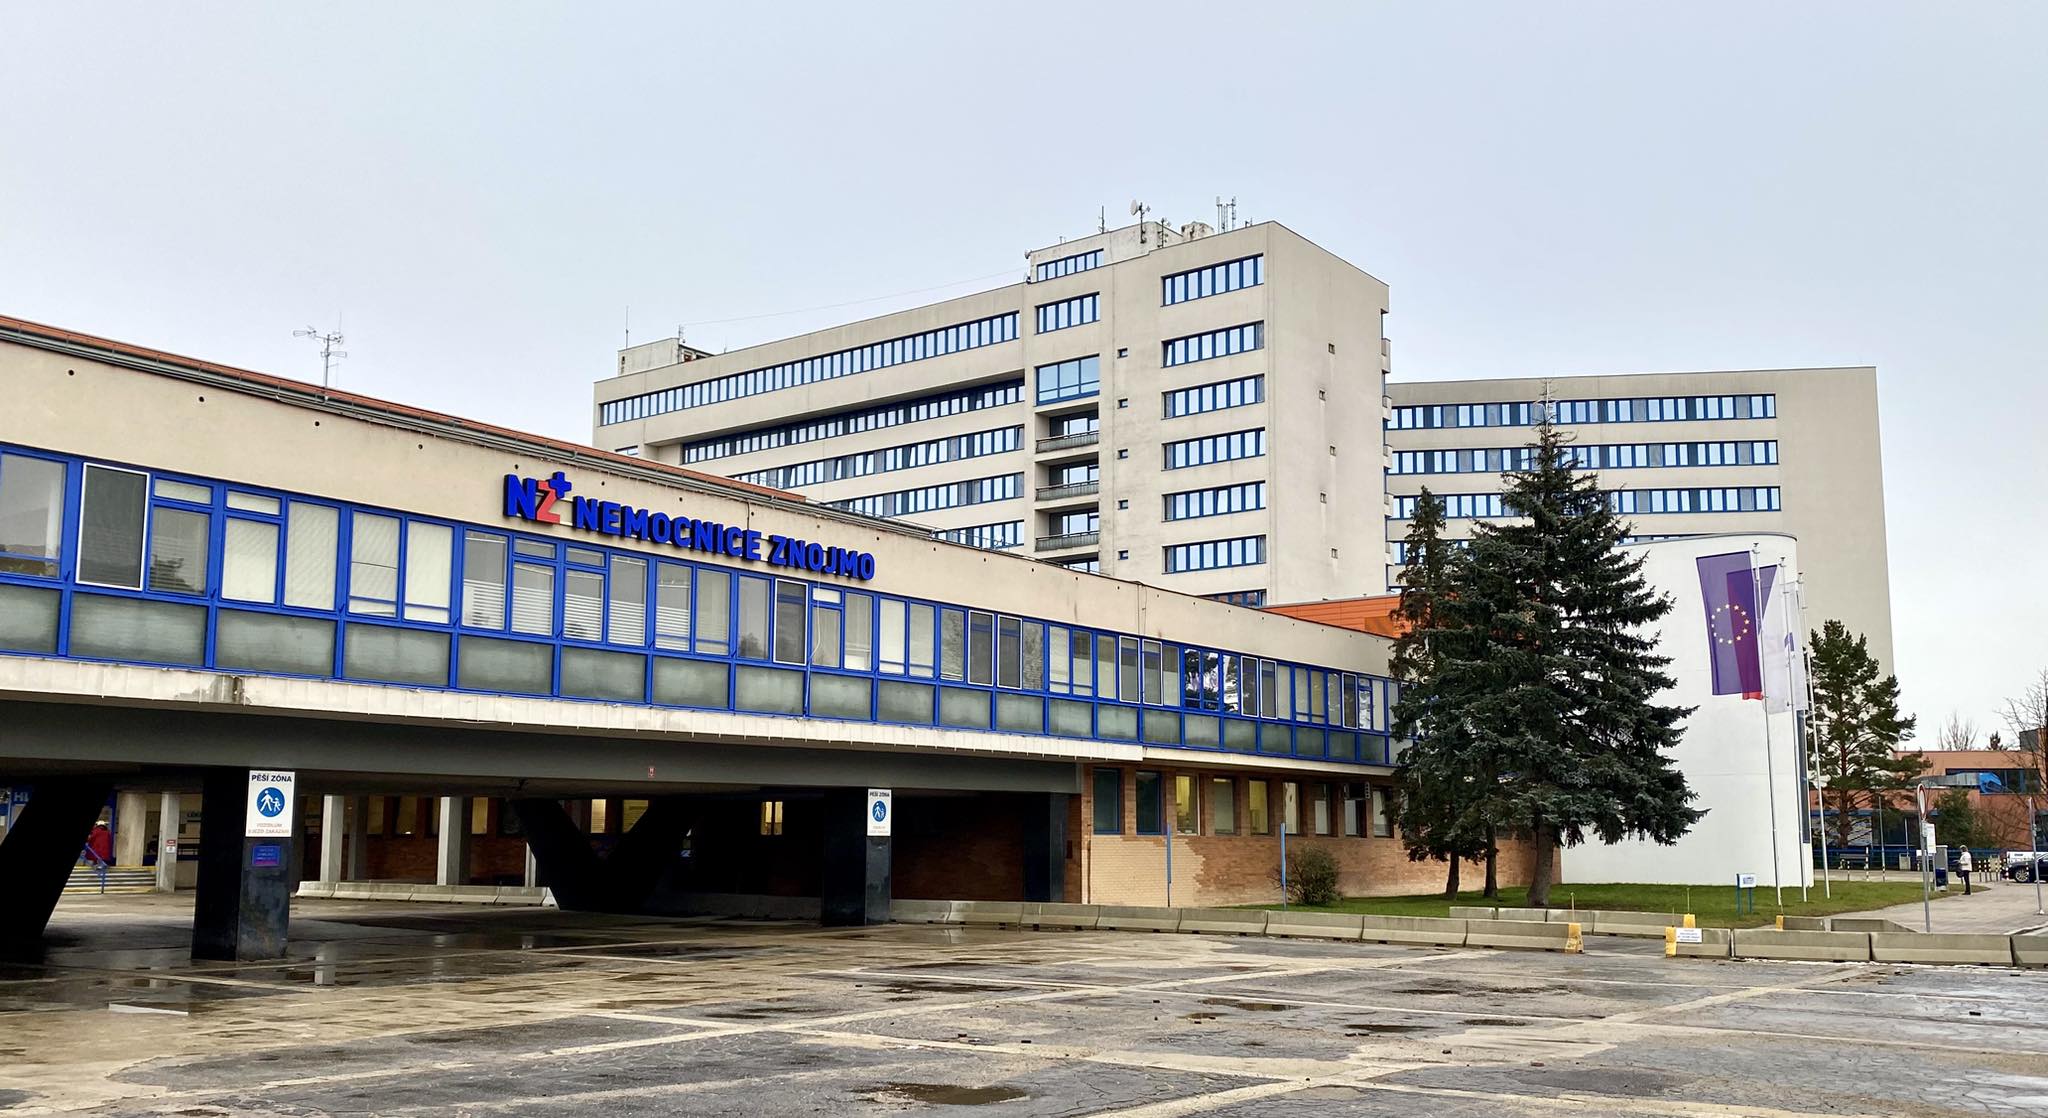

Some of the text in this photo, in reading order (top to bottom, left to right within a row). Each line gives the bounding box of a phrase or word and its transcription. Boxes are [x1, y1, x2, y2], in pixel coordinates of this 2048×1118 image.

[572, 495, 761, 561] NEMOCNICE
[768, 534, 875, 581] ZNOJMO
[271, 774, 292, 783] ZÓNA
